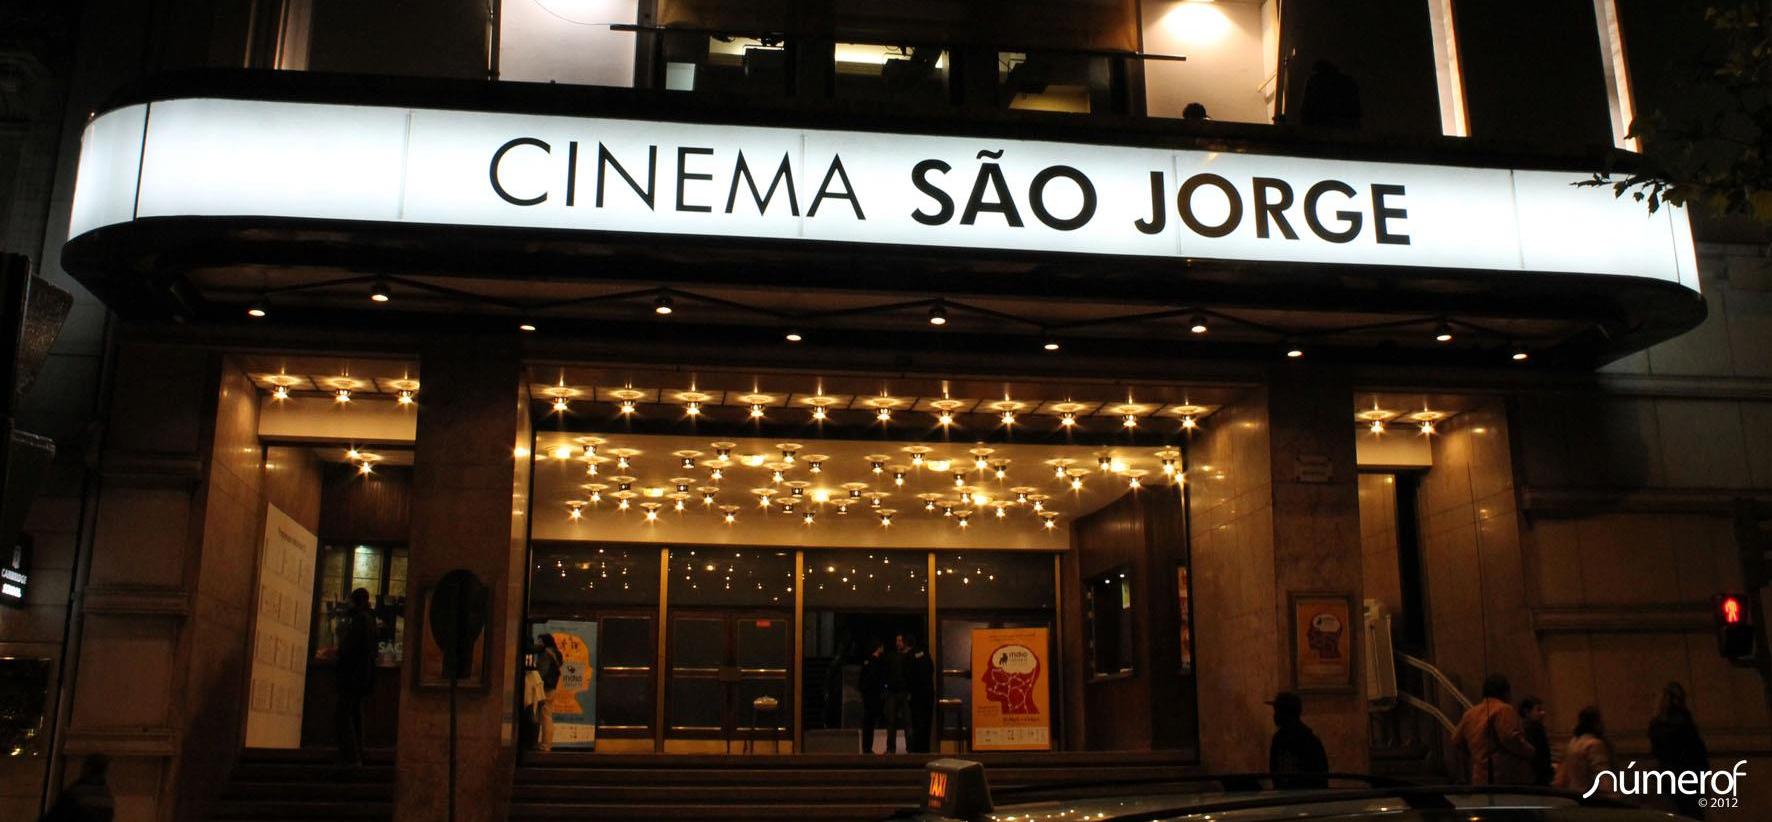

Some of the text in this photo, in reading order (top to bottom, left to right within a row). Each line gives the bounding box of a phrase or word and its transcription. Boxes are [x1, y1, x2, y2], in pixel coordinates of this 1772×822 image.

[489, 137, 1411, 246] CINEMA SÃO JORGE
[929, 772, 948, 798] TAXI
